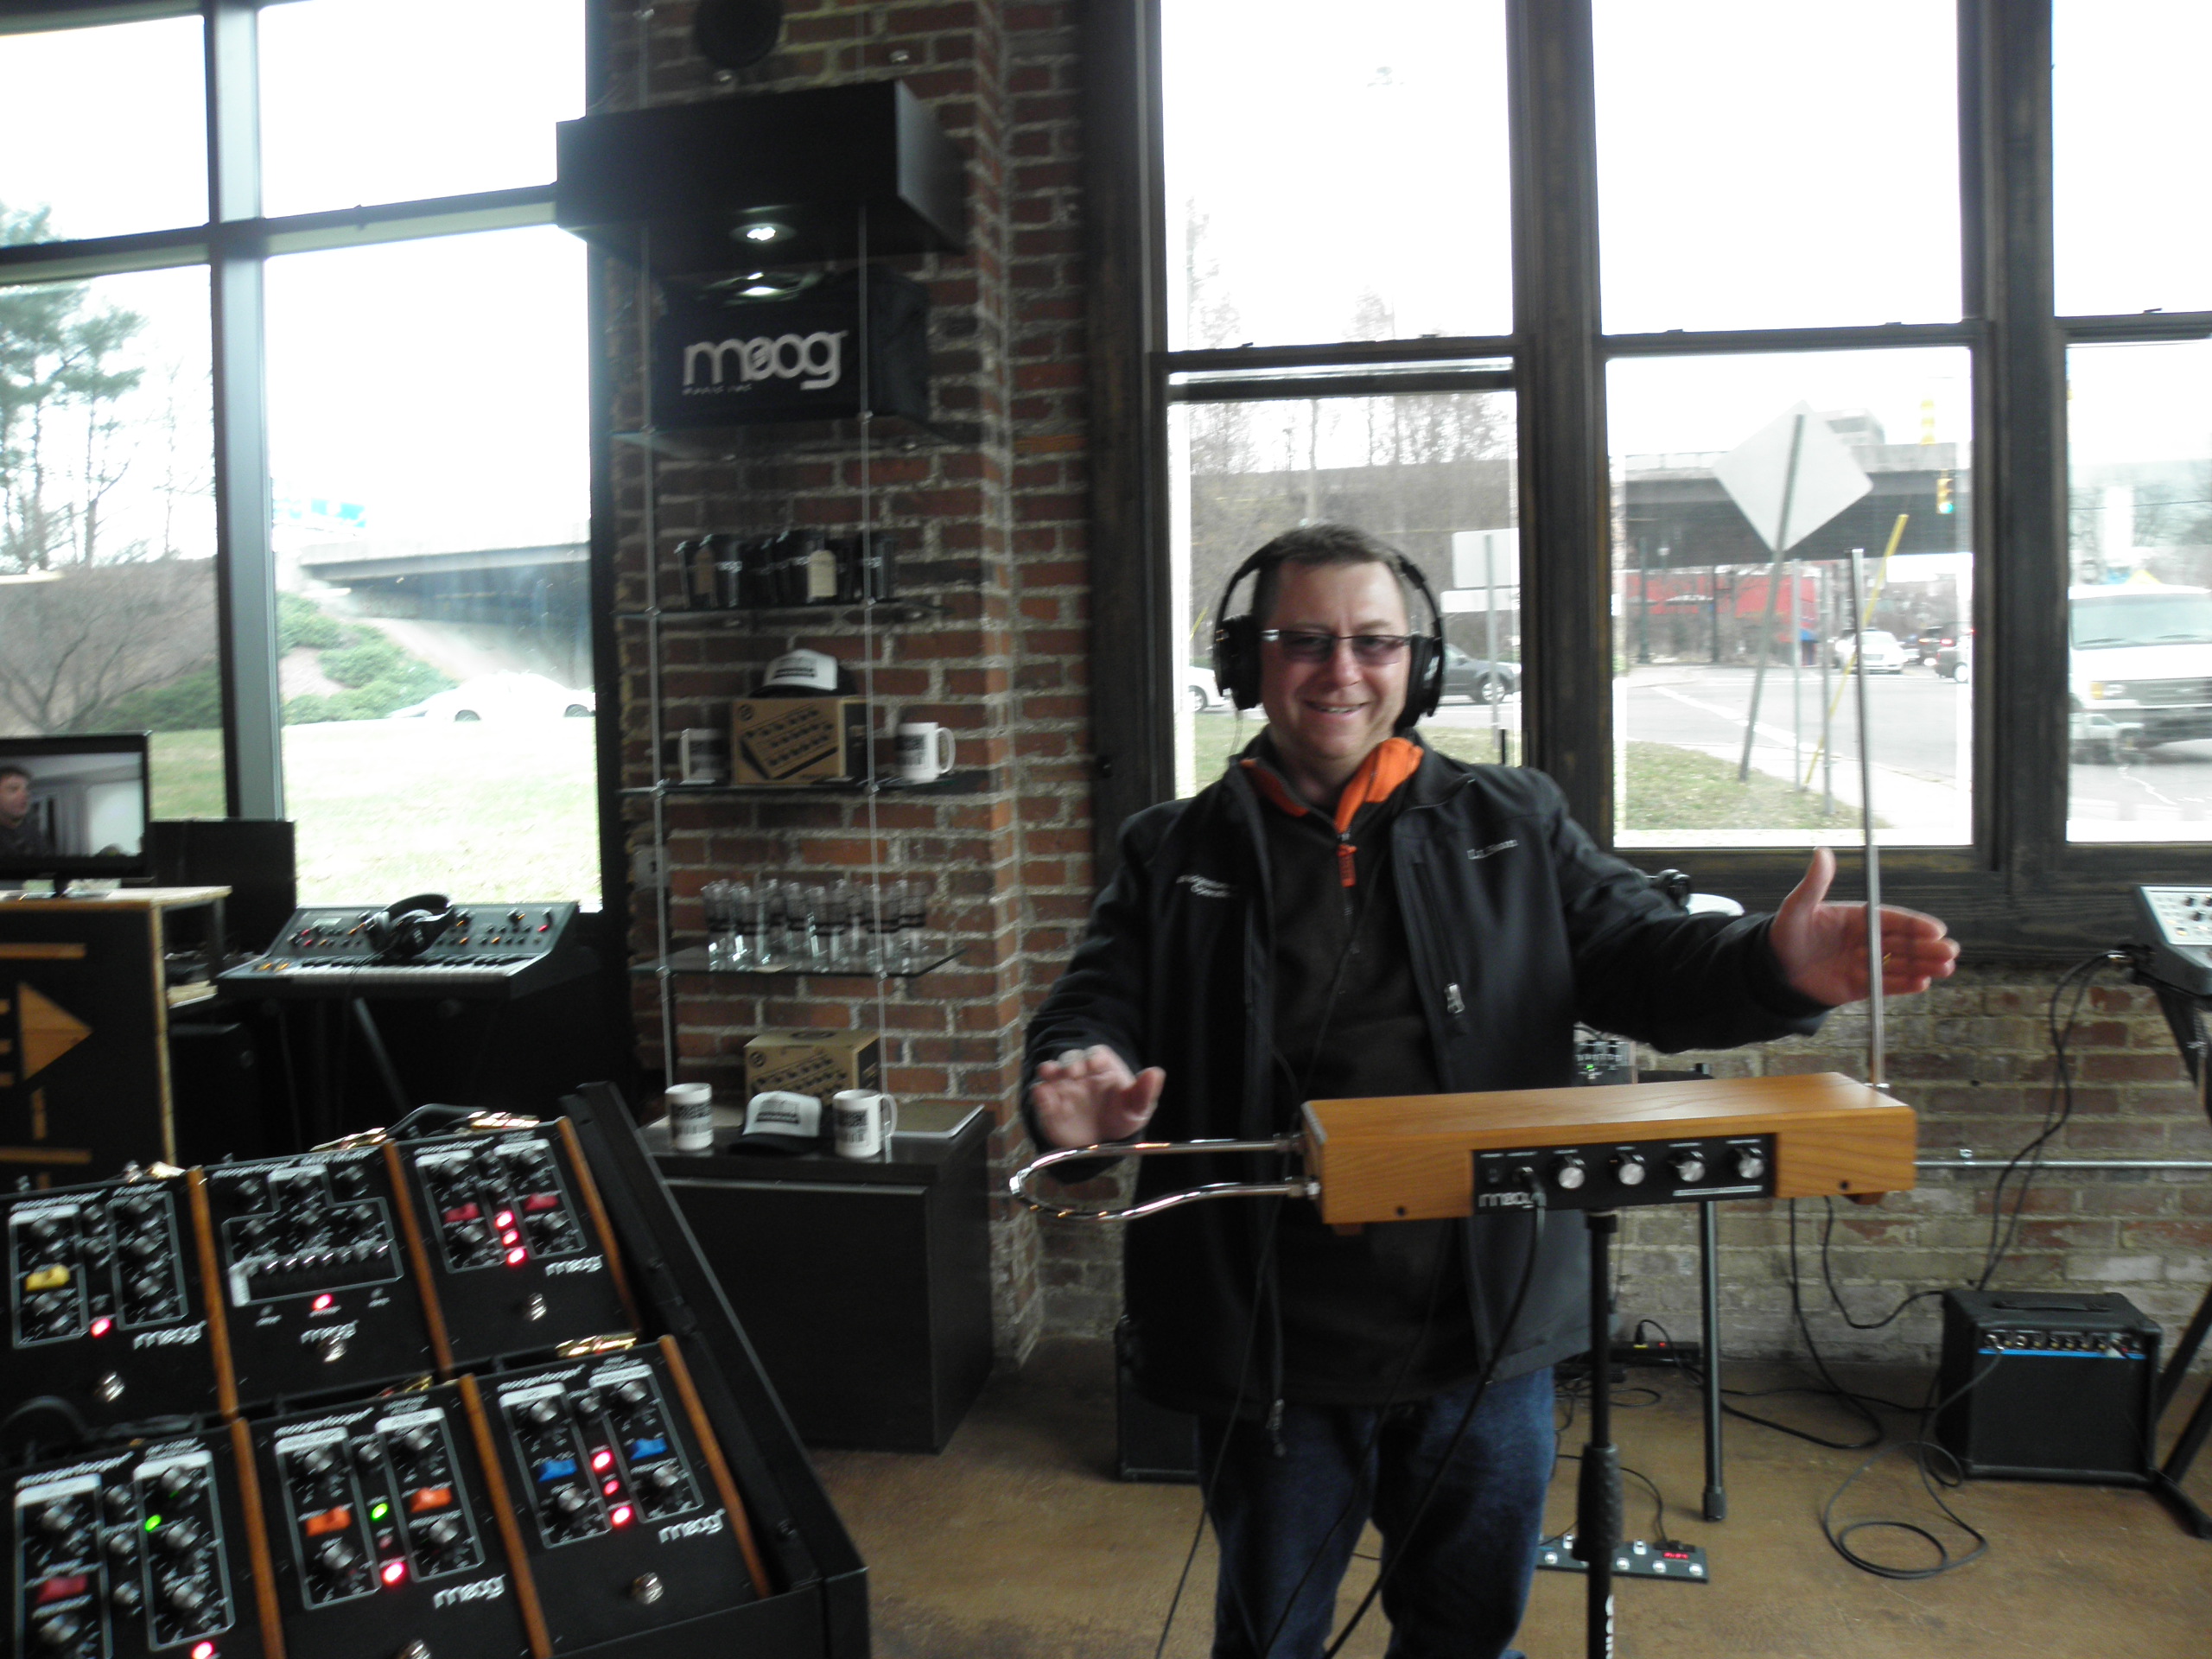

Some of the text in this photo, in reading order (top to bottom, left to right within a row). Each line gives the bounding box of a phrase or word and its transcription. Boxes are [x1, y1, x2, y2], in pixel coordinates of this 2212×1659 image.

[682, 329, 849, 391] moog
[658, 1508, 726, 1544] moog
[434, 1573, 506, 1609] moog
